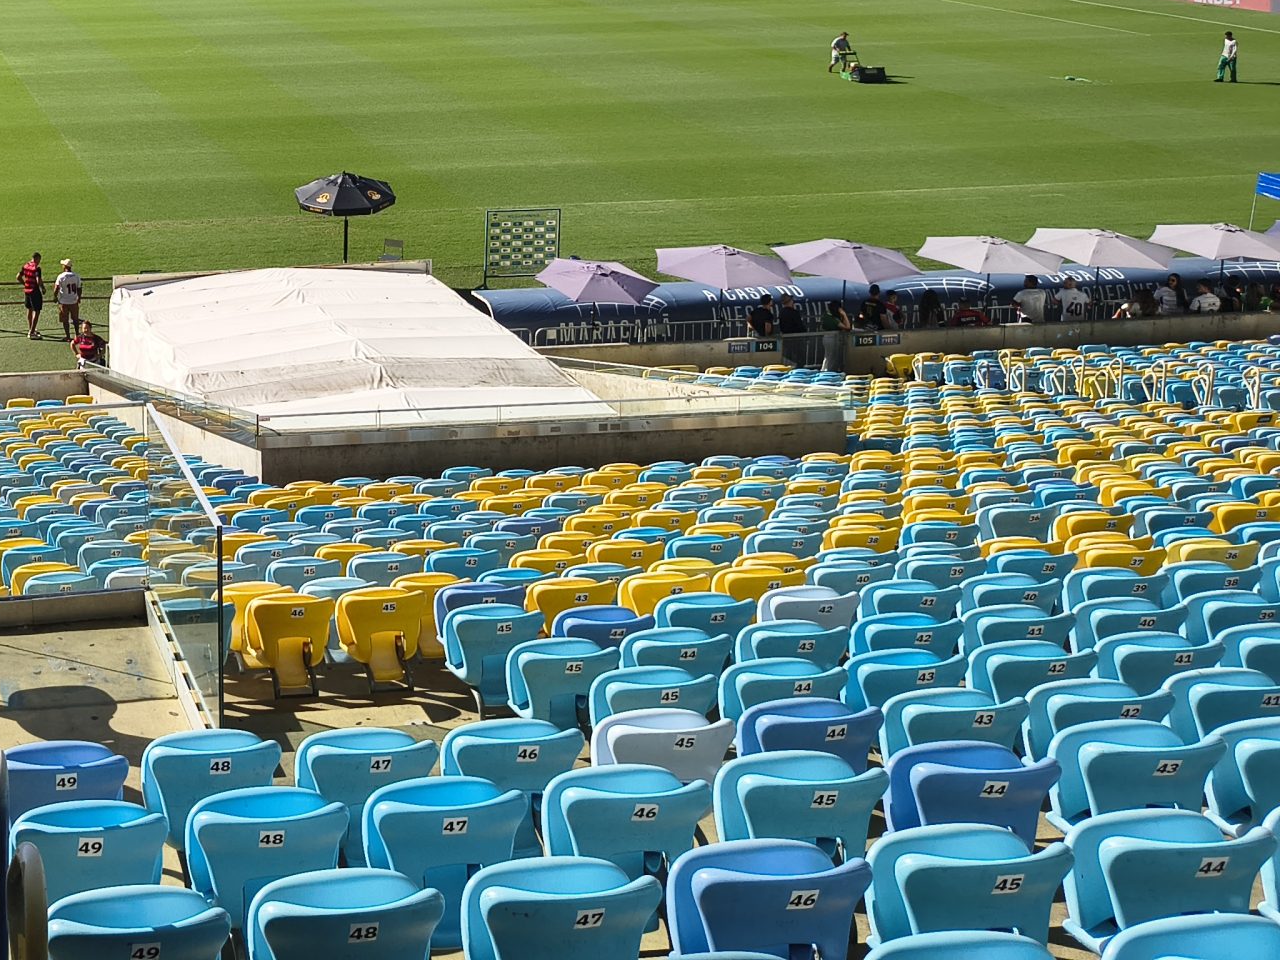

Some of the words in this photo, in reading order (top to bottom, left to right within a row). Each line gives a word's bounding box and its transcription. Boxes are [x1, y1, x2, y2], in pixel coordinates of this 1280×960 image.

[704, 291, 717, 302] A
[1066, 302, 1082, 317] 40
[560, 314, 671, 342] MARACANÃ
[1226, 552, 1238, 560] 36
[951, 568, 963, 577] 39
[1043, 564, 1055, 572] 38
[858, 575, 870, 583] 40
[1225, 579, 1239, 587] 38
[1134, 584, 1147, 592] 39
[576, 594, 588, 602] 43
[1024, 593, 1037, 601] 40
[922, 598, 935, 607] 41
[291, 609, 304, 617] 46
[383, 604, 396, 612] 45
[819, 605, 833, 614] 42
[711, 614, 724, 622] 43
[1259, 612, 1274, 620] 39
[1140, 618, 1155, 628] 40
[498, 624, 512, 633] 45
[1028, 627, 1043, 636] 41
[611, 630, 624, 638] 44
[917, 634, 931, 642] 42
[799, 642, 814, 651] 43
[681, 650, 696, 659] 44
[1176, 654, 1192, 664] 41
[567, 664, 582, 673] 45
[1049, 664, 1065, 673] 42
[919, 672, 934, 682] 43
[795, 683, 811, 693] 44
[662, 691, 678, 702] 45
[1263, 696, 1280, 706] 41
[1122, 708, 1140, 718] 42
[974, 714, 994, 726] 43
[826, 727, 846, 739] 44
[675, 738, 694, 749] 45
[518, 748, 538, 760] 46
[210, 761, 230, 773] 48
[371, 759, 391, 771] 47
[1157, 763, 1180, 775] 43
[57, 777, 77, 788] 49
[981, 783, 1006, 795] 44
[813, 793, 837, 806] 45
[633, 807, 656, 819] 46
[444, 821, 467, 832] 47
[260, 833, 284, 845] 48
[79, 841, 102, 854] 49
[1198, 860, 1226, 874] 44
[994, 878, 1022, 891] 45
[790, 894, 814, 907] 46
[576, 912, 604, 926] 47
[350, 926, 378, 940] 48
[132, 946, 160, 960] 49
